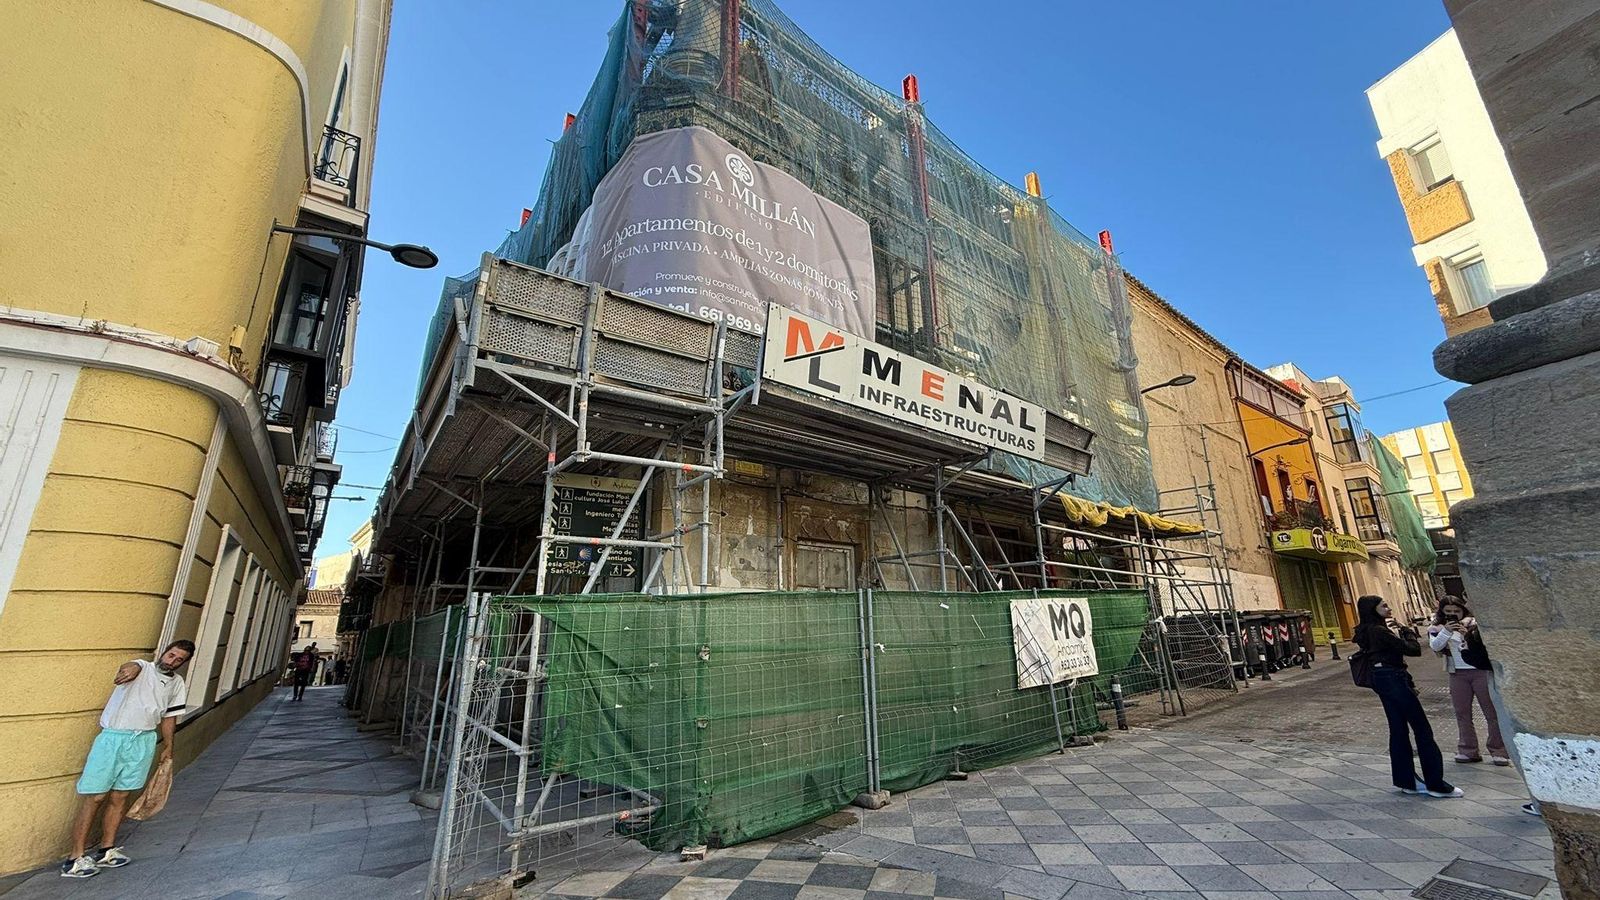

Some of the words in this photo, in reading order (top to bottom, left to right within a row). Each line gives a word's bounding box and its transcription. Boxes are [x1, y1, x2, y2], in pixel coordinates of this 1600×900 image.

[642, 164, 724, 192] CASA
[730, 177, 815, 239] MILLÁN
[704, 190, 773, 230] EDIFICIO
[601, 238, 613, 259] 12
[614, 218, 734, 247] Apartamentos
[735, 229, 754, 250] de
[755, 242, 763, 256] 1
[764, 247, 774, 262] y
[775, 251, 785, 265] 2
[652, 240, 711, 255] PRIVADA
[720, 249, 768, 276] AMPLIAS
[769, 268, 802, 291] ZONAS
[655, 272, 704, 282] Promueve
[705, 277, 711, 286] y
[655, 286, 662, 295] y
[664, 285, 698, 294] venta:
[699, 305, 724, 321] 661
[726, 313, 752, 331] 969
[862, 347, 1037, 432] MENAL
[859, 384, 1036, 451] INFRAESTRUCTURAS
[585, 509, 615, 518] Ingeniero
[617, 512, 638, 520] Tooja
[606, 555, 632, 563] antiago
[1047, 603, 1086, 640] MQ
